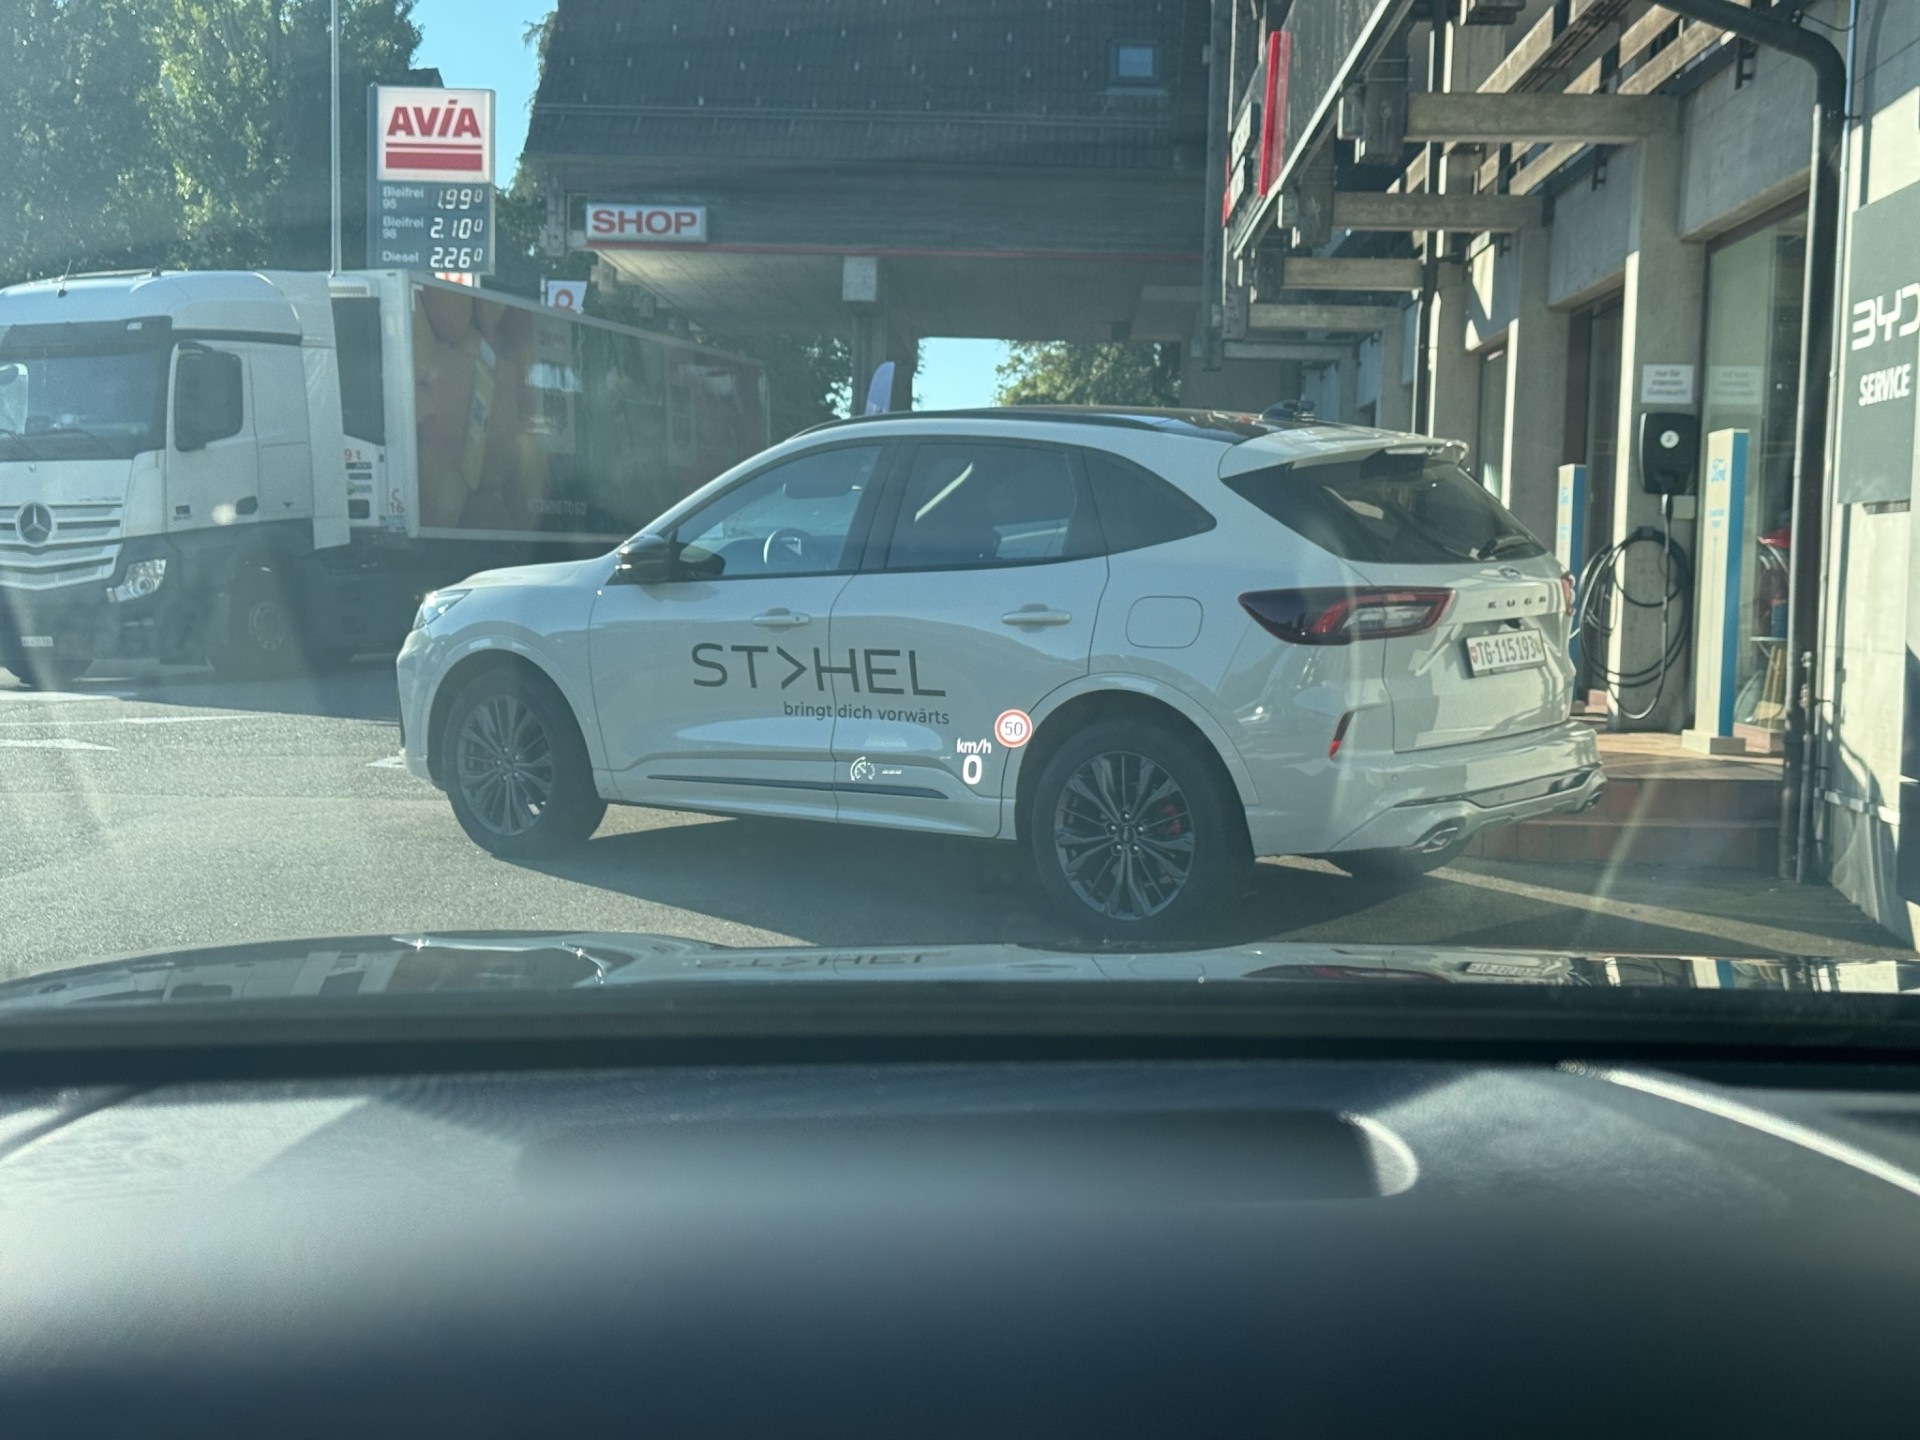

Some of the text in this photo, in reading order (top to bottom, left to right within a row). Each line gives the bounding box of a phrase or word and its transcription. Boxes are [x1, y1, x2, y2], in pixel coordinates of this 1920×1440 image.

[382, 187, 424, 198] Bleifrei
[382, 199, 397, 209] 95
[382, 216, 424, 228] Bleifrei
[592, 209, 697, 235] SHOP
[382, 250, 419, 262] Diesel
[1851, 282, 1920, 351] BYD
[1859, 362, 1912, 407] SERVICE
[783, 701, 949, 725] bringt dich vorwärts
[1004, 721, 1023, 737] 50
[956, 738, 992, 754] km/h
[962, 754, 983, 785] 0
